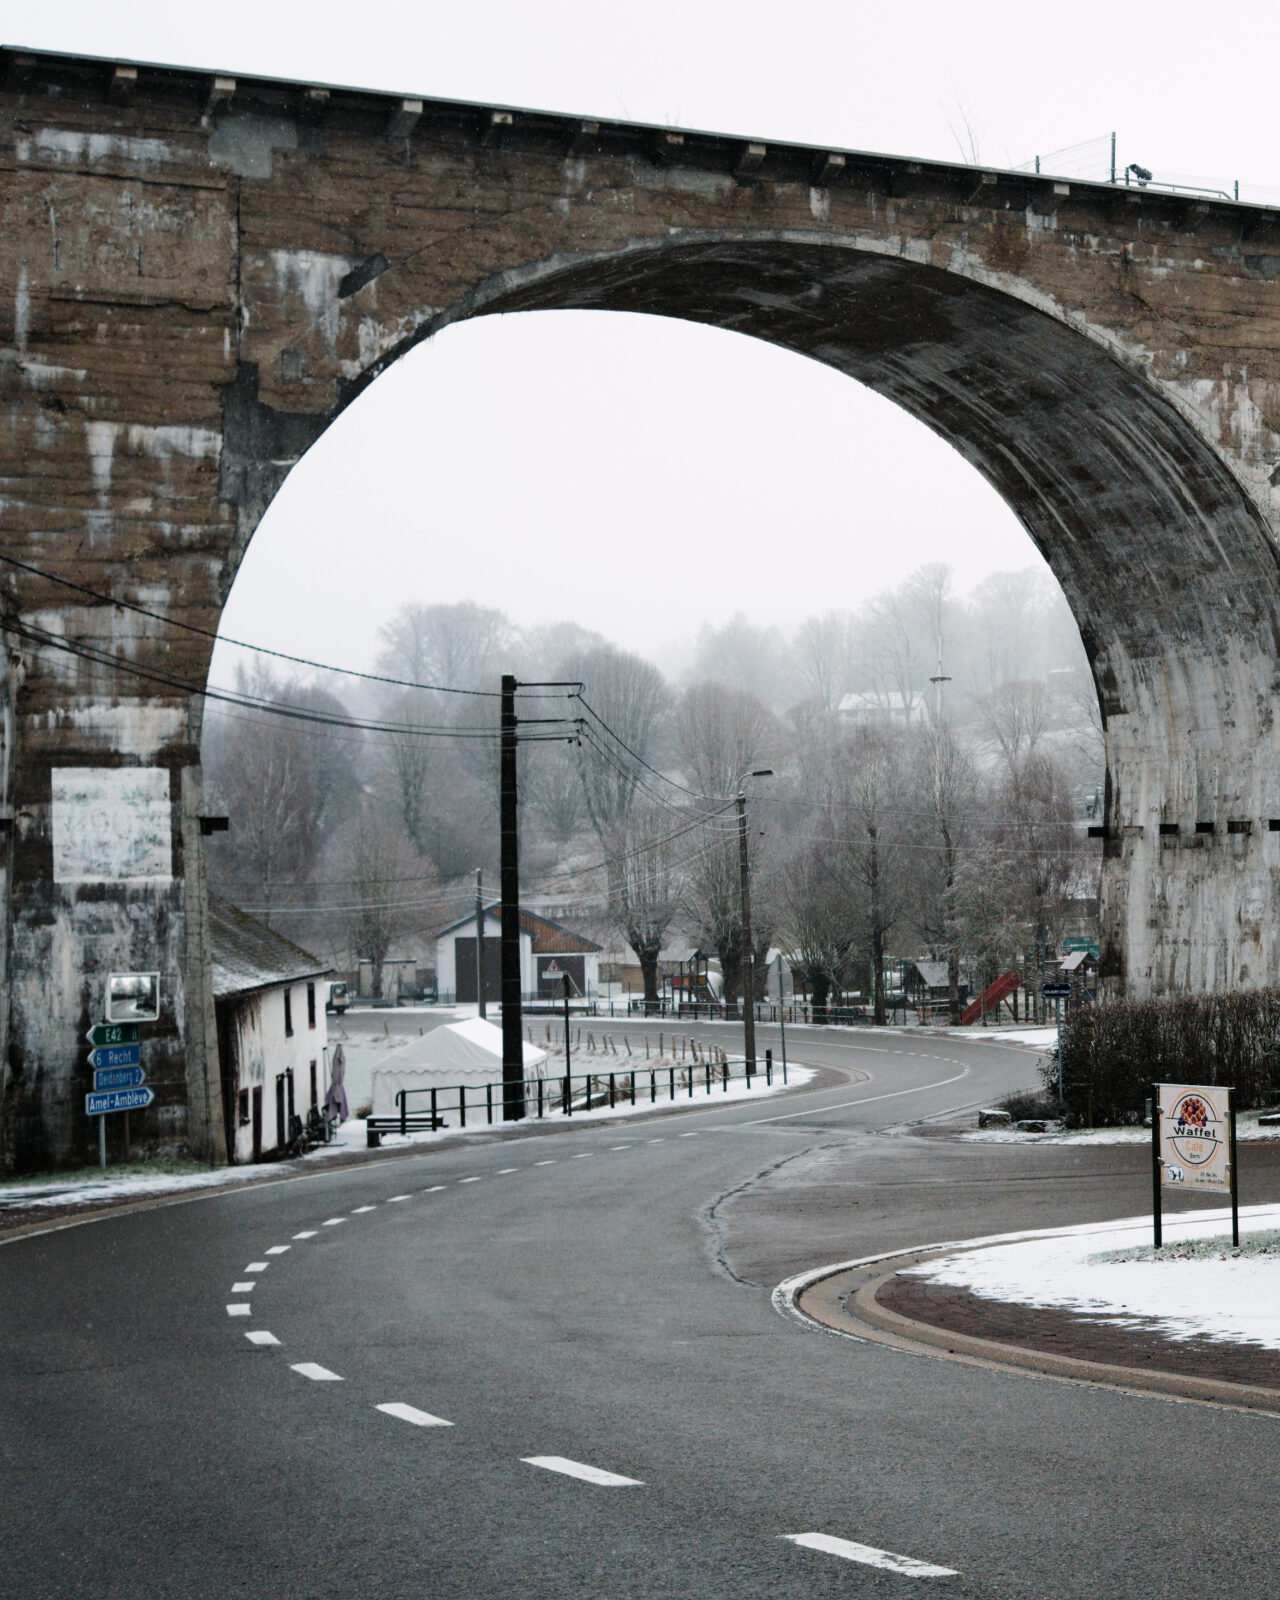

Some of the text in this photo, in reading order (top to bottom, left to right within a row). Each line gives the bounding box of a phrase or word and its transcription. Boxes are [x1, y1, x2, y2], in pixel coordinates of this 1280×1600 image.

[105, 1028, 122, 1042] E42
[96, 1050, 132, 1066] 6 Recht
[89, 1091, 148, 1112] Amel-Amblève
[1173, 1126, 1216, 1138] Waffel
